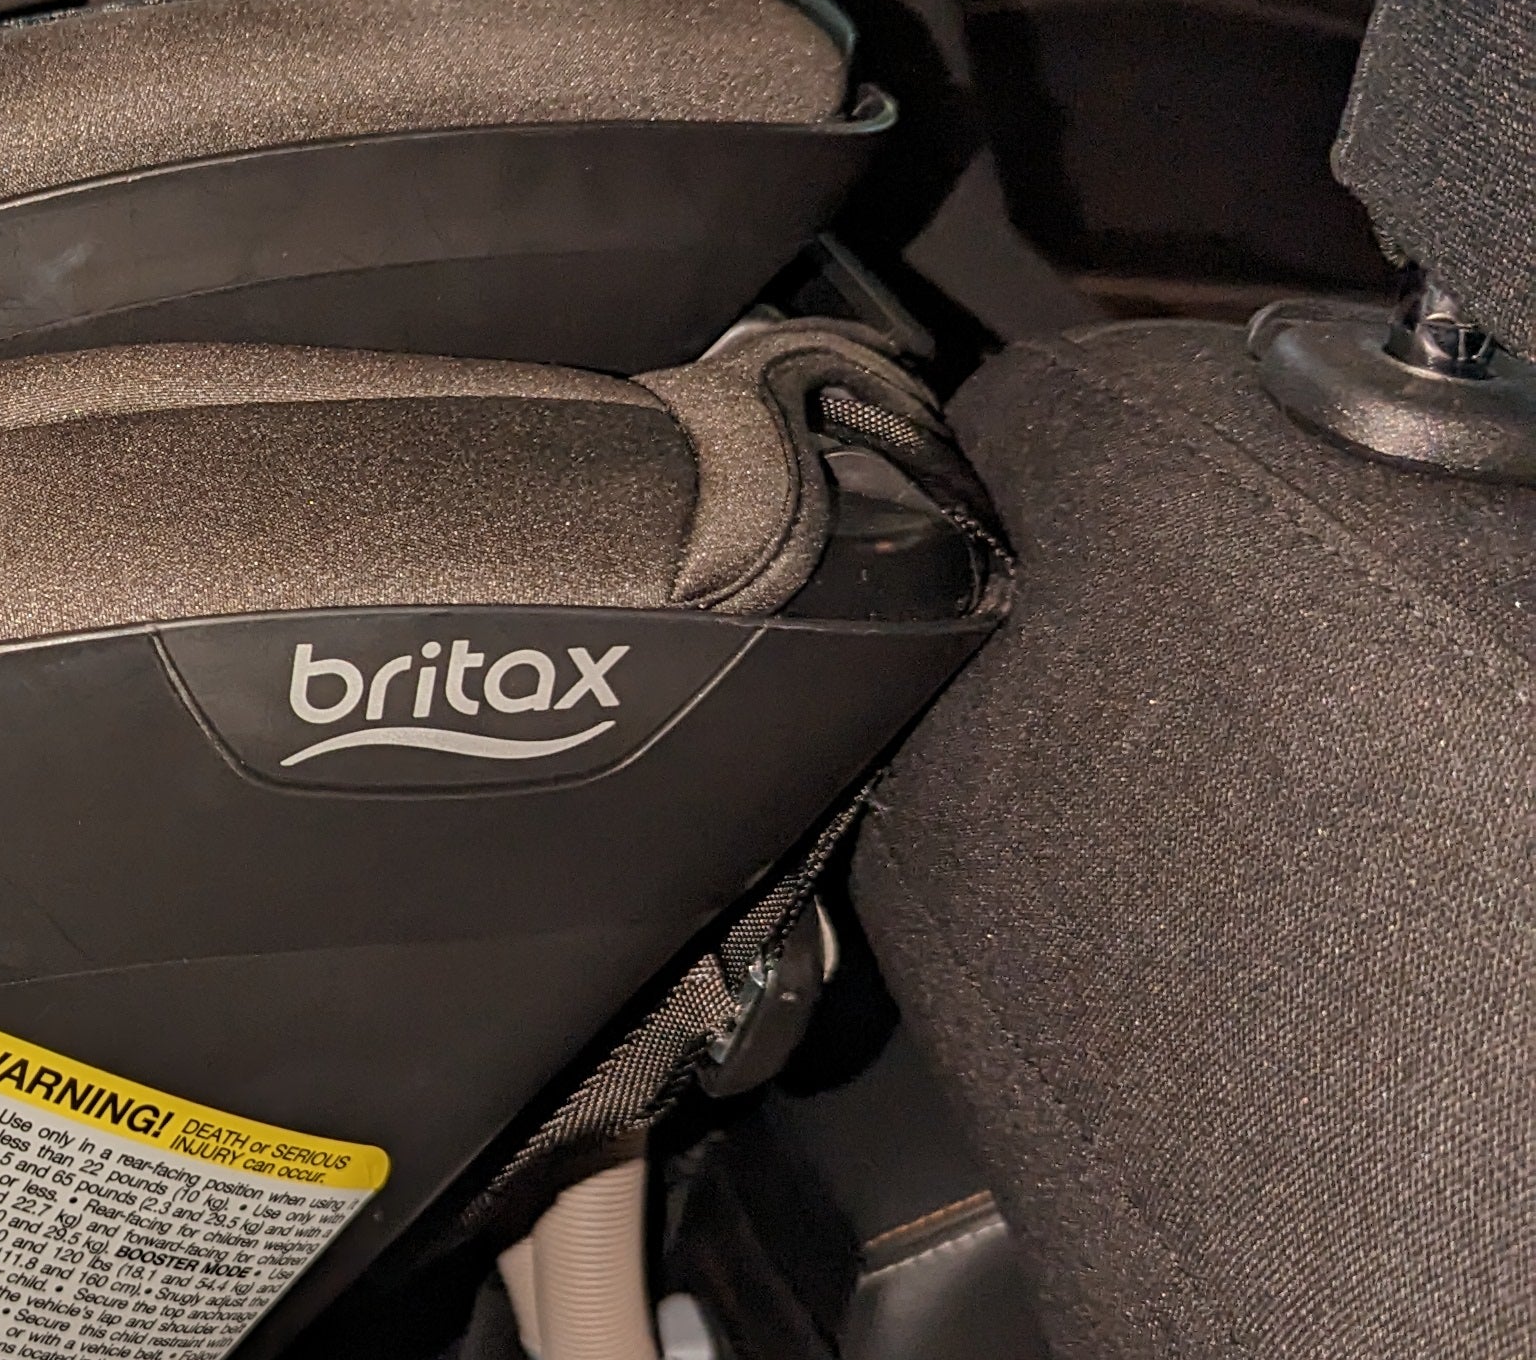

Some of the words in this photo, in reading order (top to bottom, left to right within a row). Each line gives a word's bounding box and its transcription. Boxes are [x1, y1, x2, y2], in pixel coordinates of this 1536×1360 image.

[289, 640, 630, 724] britax
[169, 1135, 245, 1165] INJURY
[242, 1158, 276, 1174] can
[277, 1166, 326, 1184] occur.
[181, 1118, 251, 1149] DEATH
[249, 1142, 271, 1154] or
[271, 1144, 351, 1170] SERIOUS
